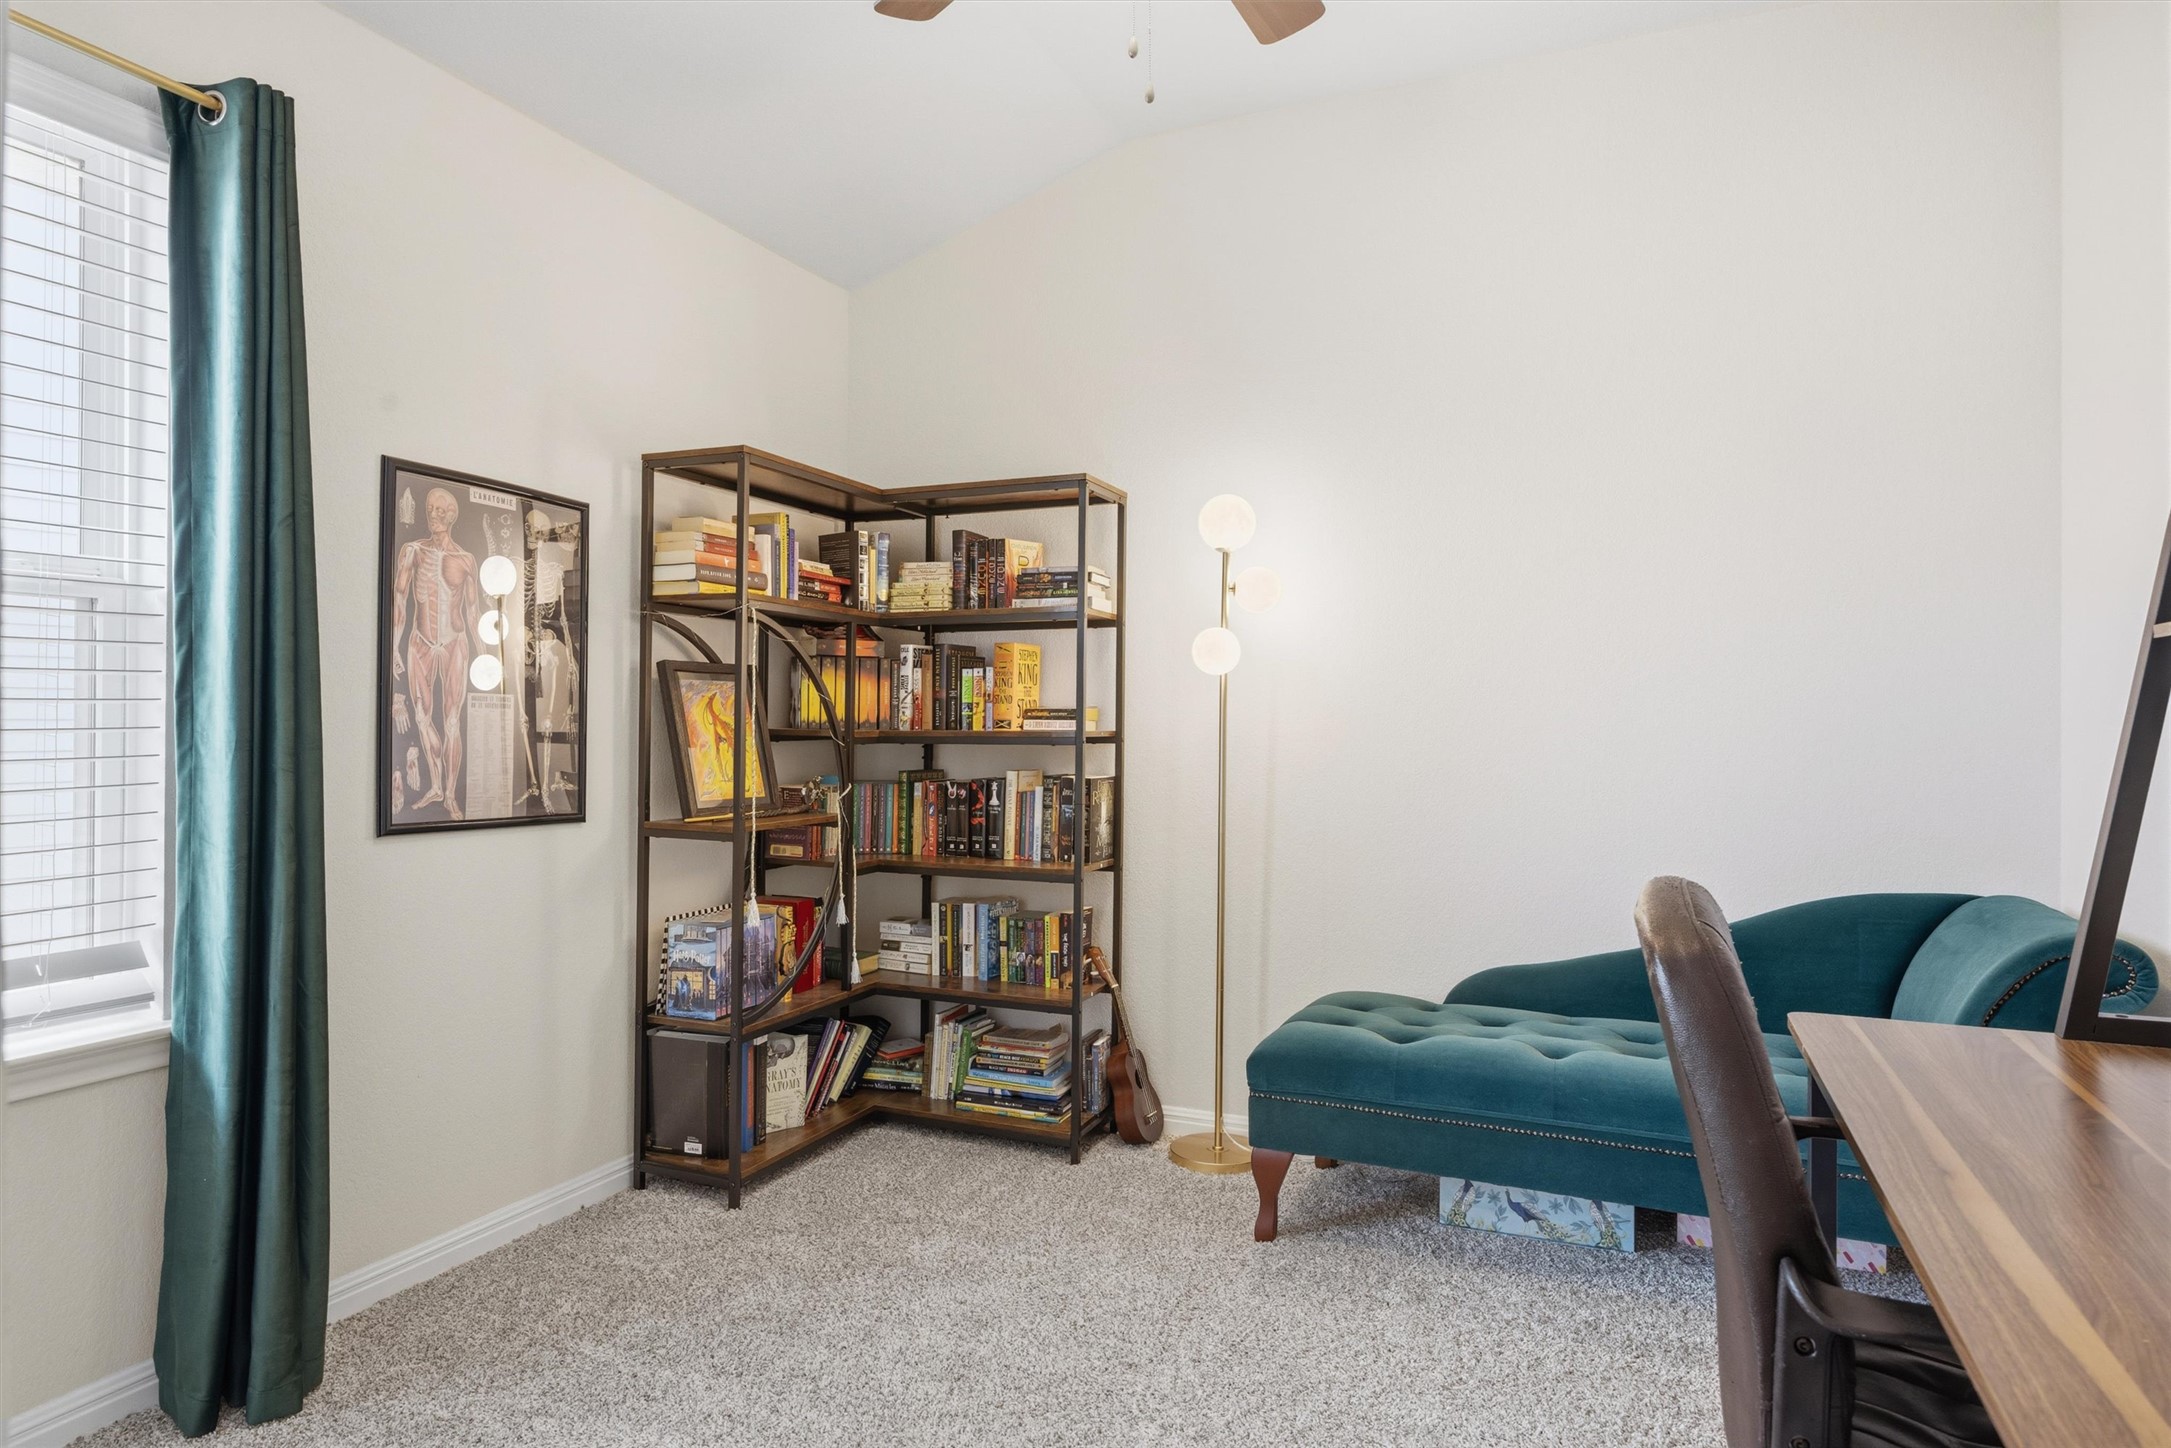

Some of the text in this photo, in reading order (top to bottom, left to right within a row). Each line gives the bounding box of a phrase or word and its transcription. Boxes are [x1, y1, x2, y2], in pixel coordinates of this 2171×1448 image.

[473, 491, 514, 507] L'ANATOMIE
[977, 564, 986, 595] DUNE
[997, 566, 1006, 594] DUNE
[1018, 648, 1038, 662] STEPHEN
[1017, 663, 1038, 687] KING
[993, 695, 1013, 704] STAND
[672, 948, 712, 965] Harry Potter
[766, 1078, 801, 1093] NATOMY
